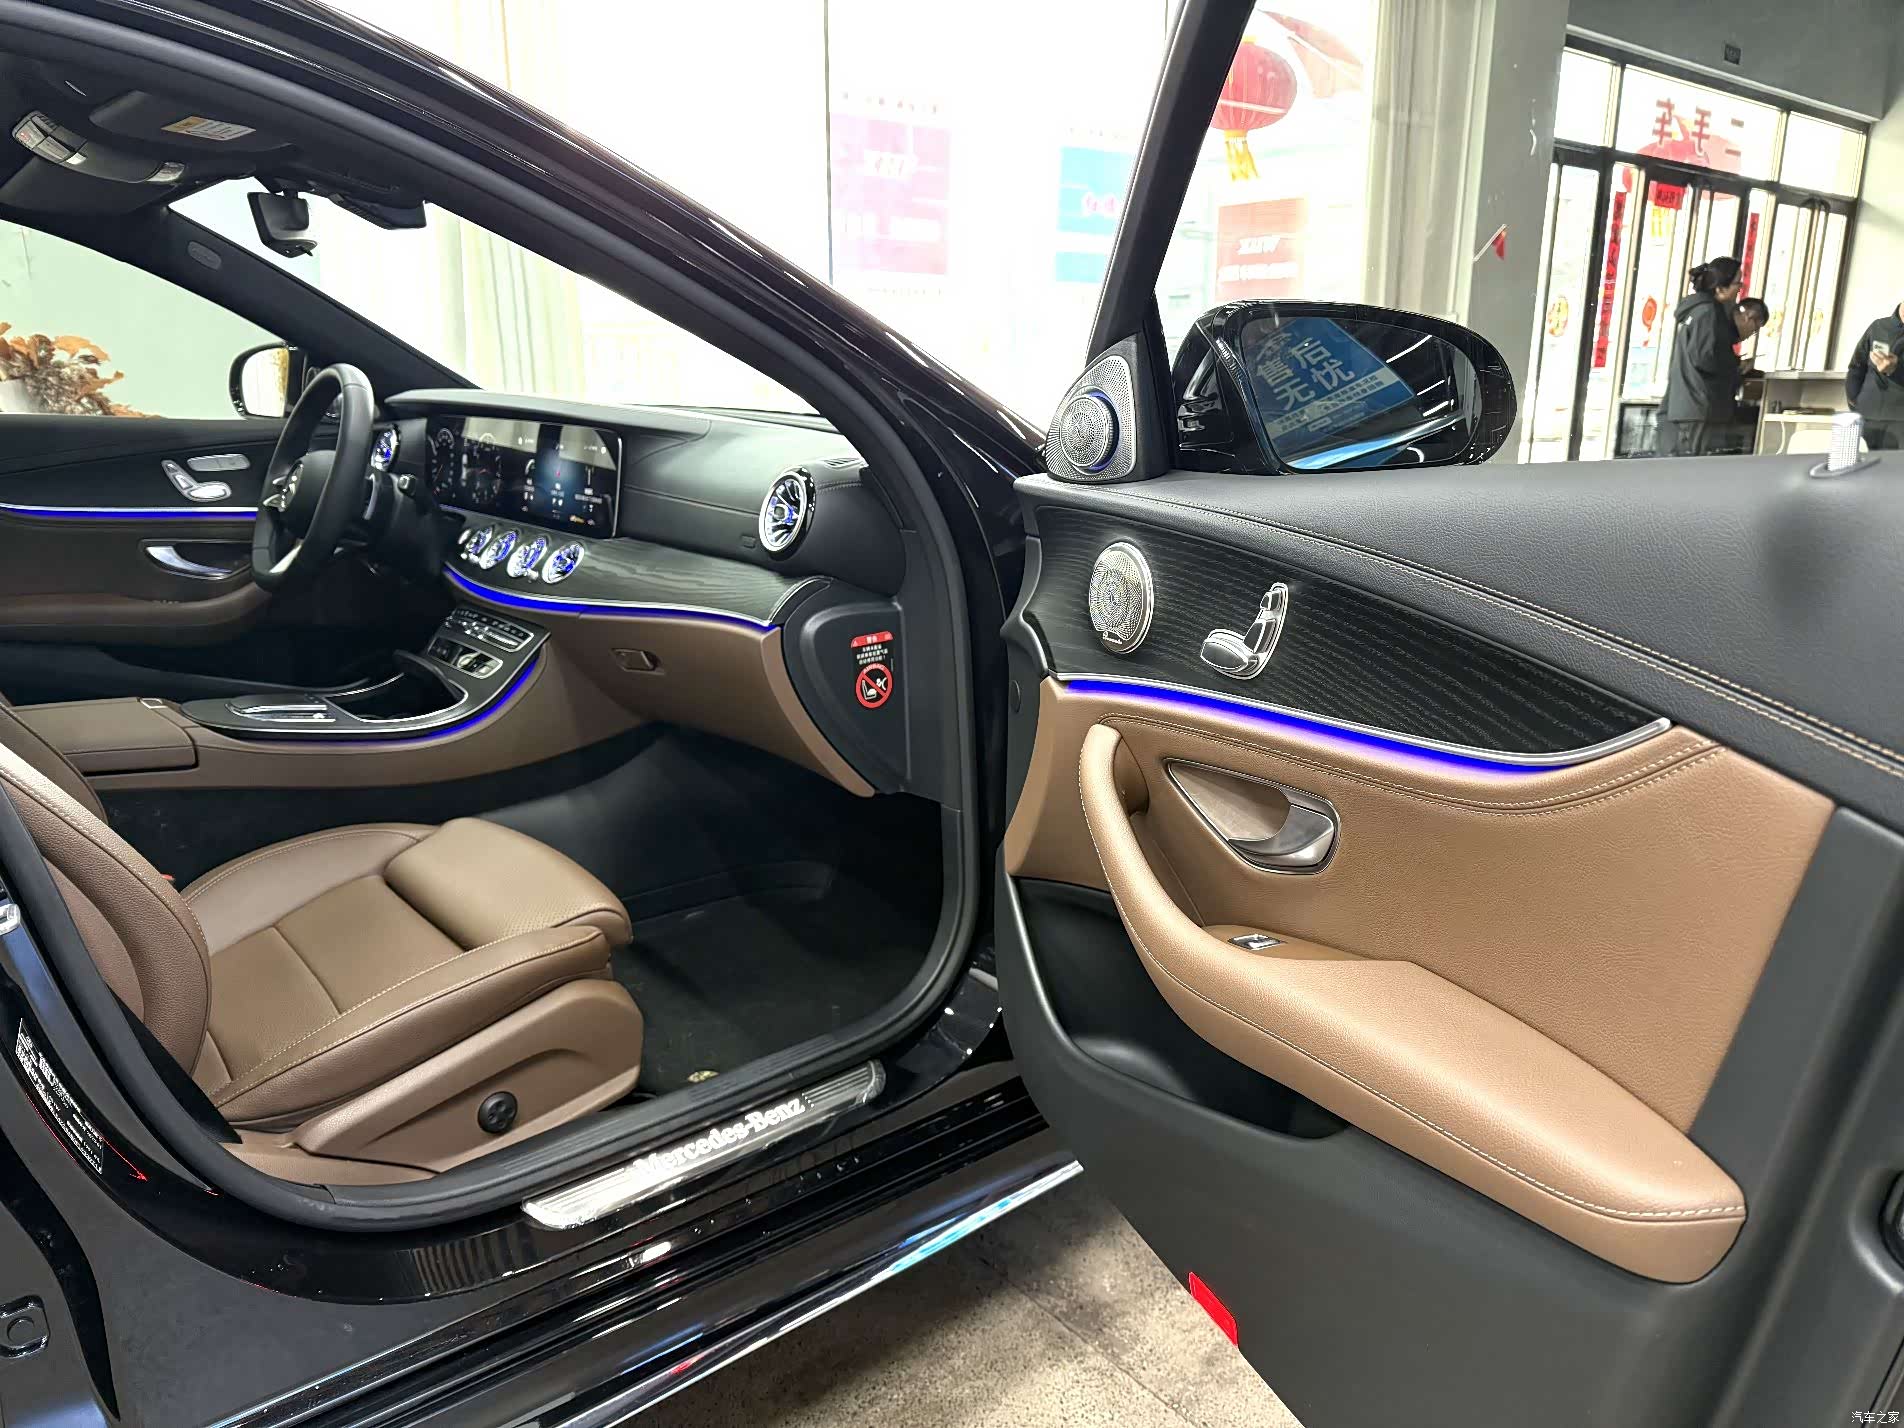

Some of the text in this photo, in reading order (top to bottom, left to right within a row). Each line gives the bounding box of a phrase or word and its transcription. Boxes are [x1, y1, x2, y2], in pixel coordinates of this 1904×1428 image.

[1257, 337, 1331, 386] 售后
[1273, 359, 1356, 411] 无忧
[633, 1097, 806, 1176] Mercedes-Benz
